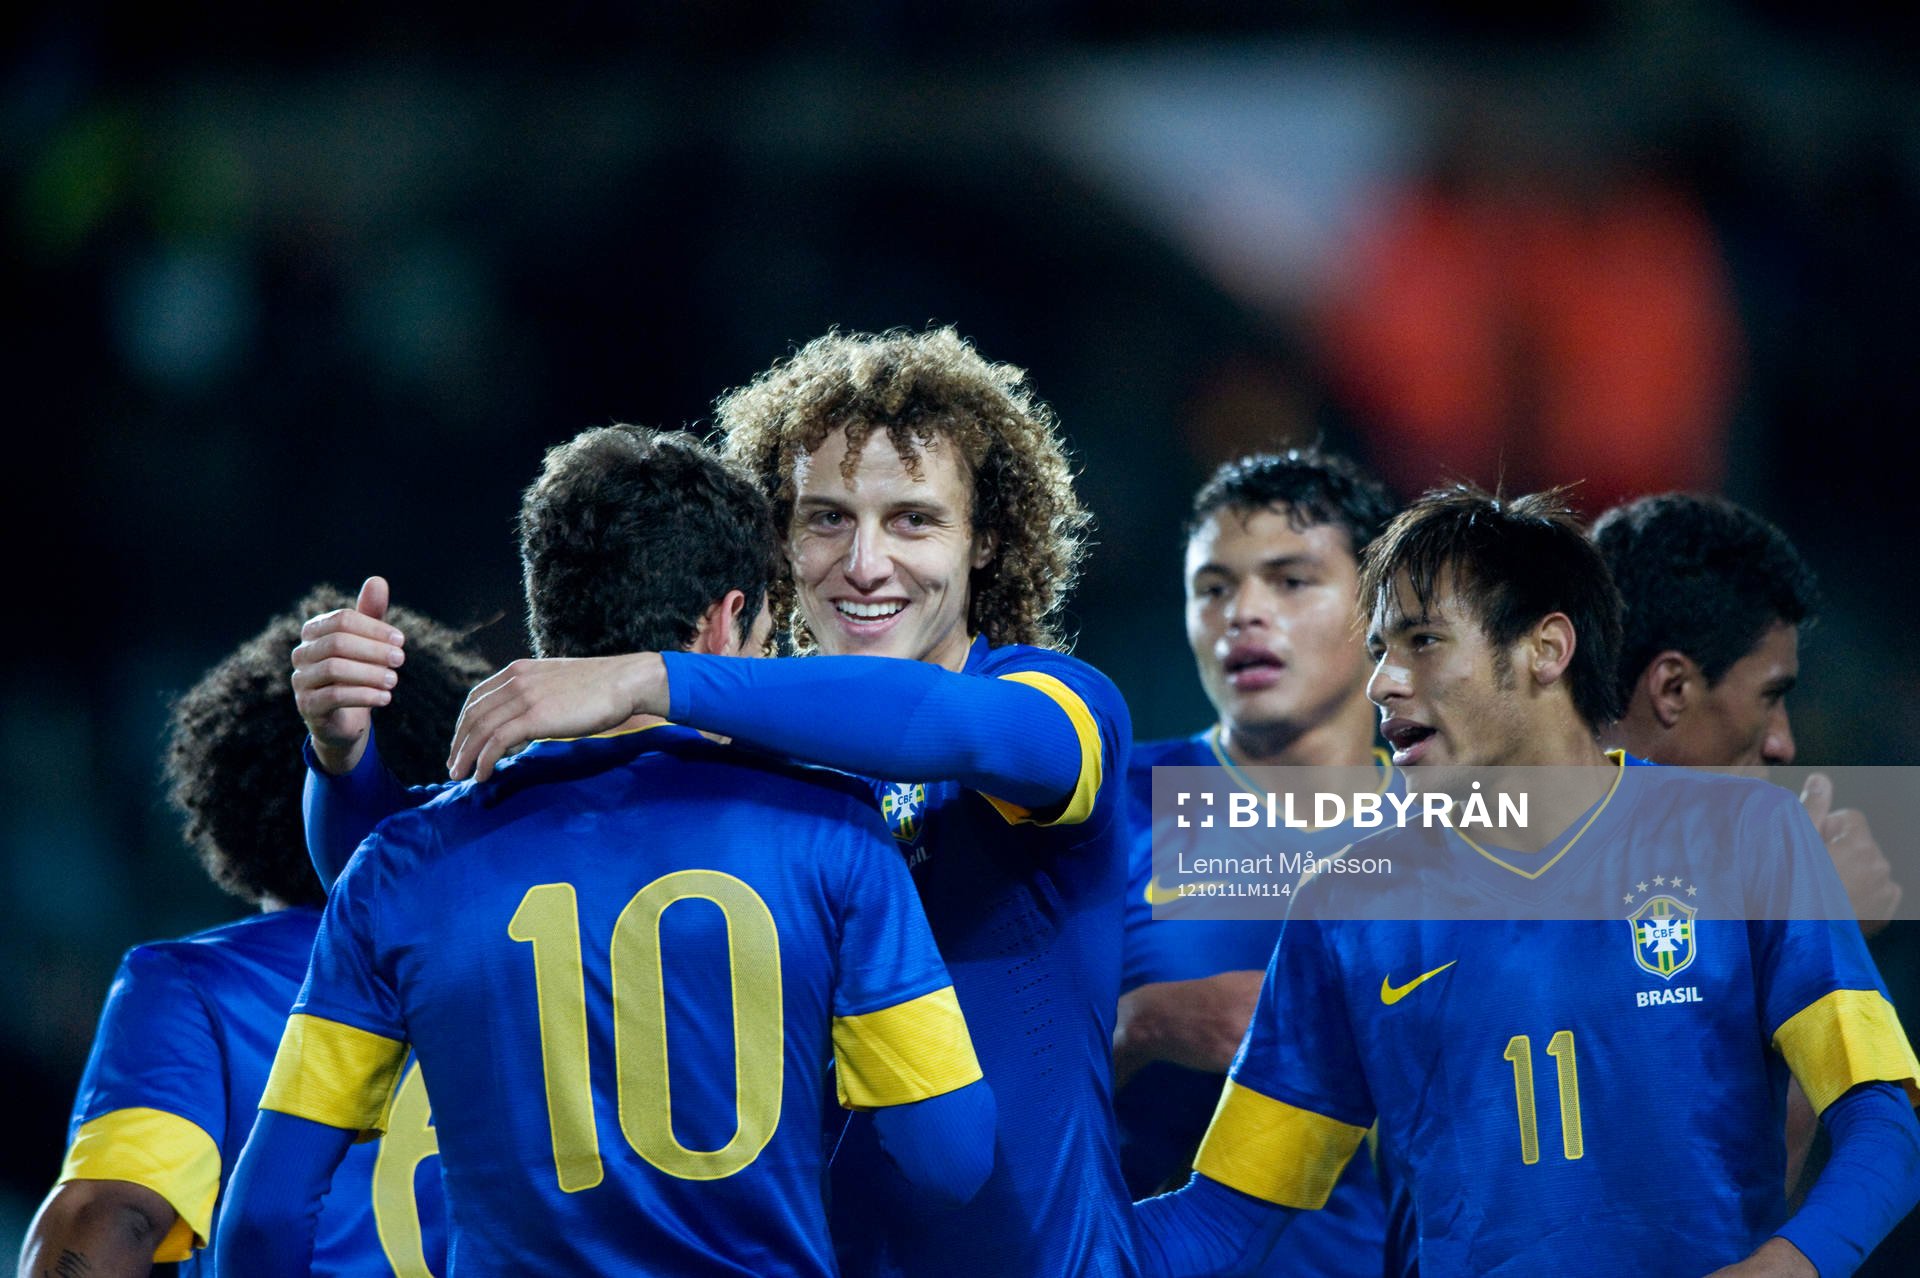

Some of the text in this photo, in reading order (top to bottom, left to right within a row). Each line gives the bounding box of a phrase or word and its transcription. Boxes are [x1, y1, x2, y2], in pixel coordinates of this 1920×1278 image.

[897, 793, 914, 806] CBF
[1652, 927, 1675, 939] CBF
[1636, 986, 1703, 1008] BRASIL
[508, 869, 784, 1194] 10
[1503, 1030, 1585, 1166] 11
